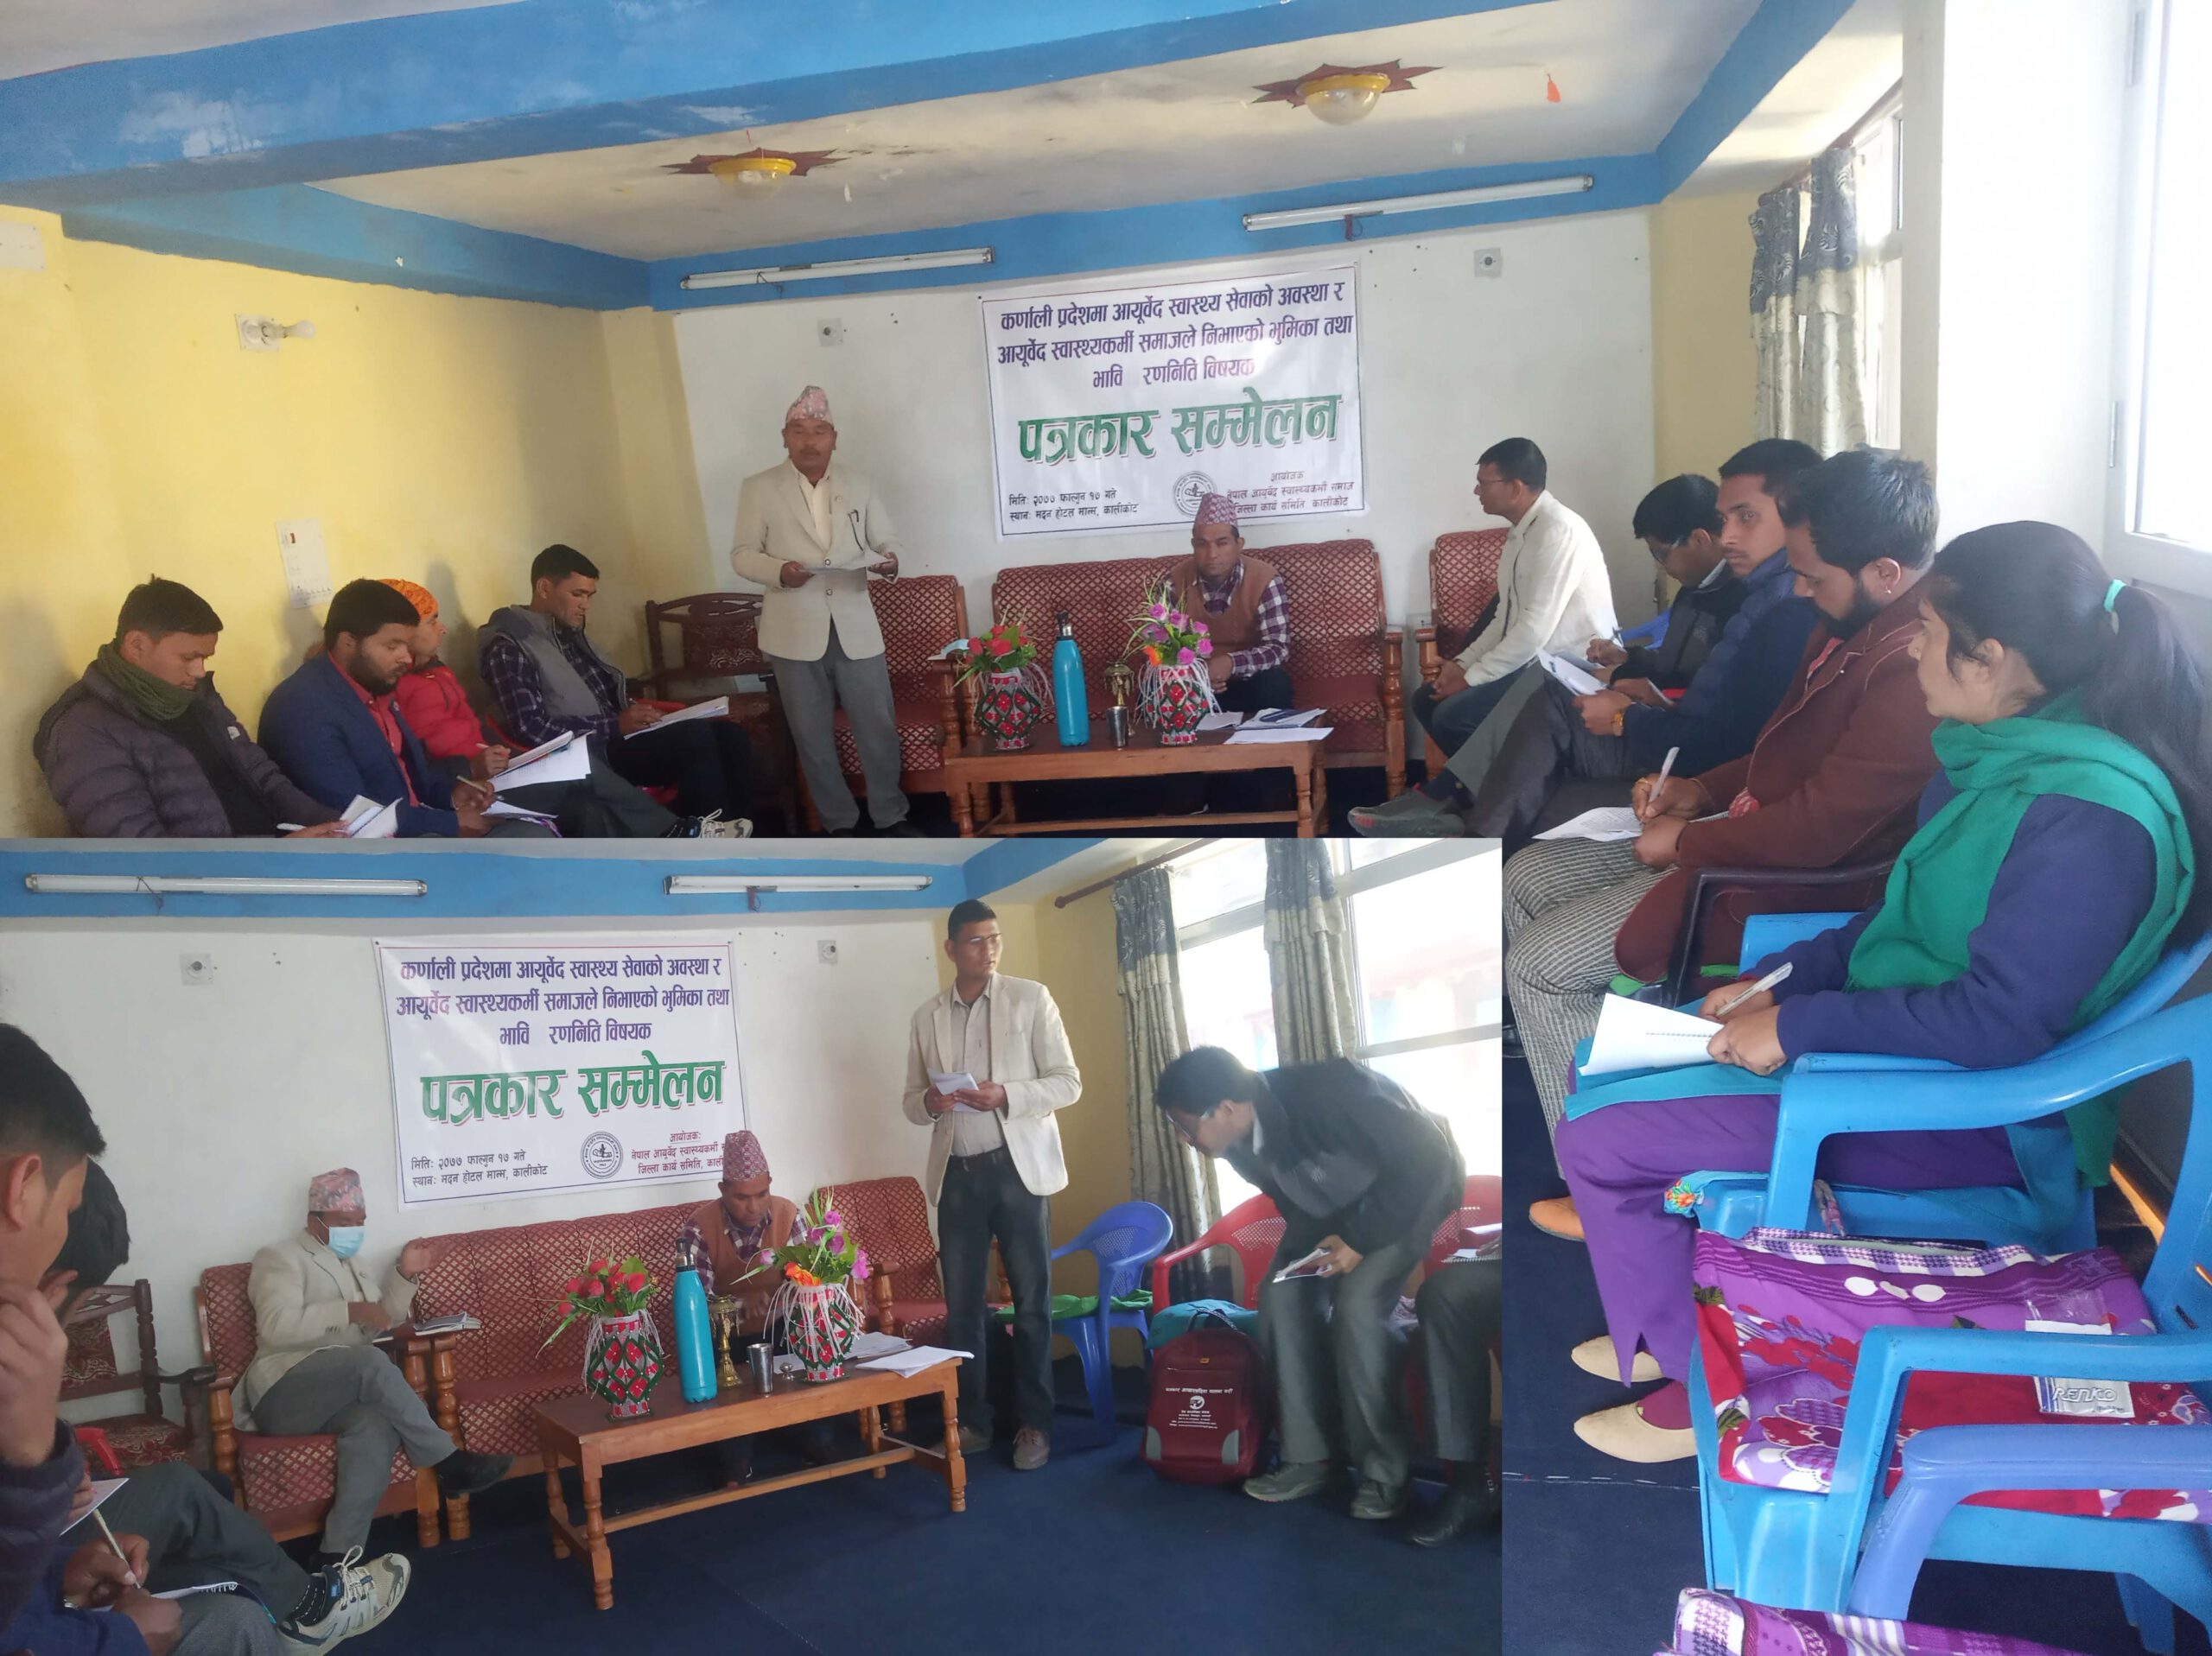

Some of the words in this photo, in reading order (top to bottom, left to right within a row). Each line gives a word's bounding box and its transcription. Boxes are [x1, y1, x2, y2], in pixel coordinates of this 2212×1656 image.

[1001, 304, 1052, 330] कर्णाली
[1058, 302, 1108, 328] प्रदेशमा
[1112, 295, 1164, 324] आयूर्वेद
[1168, 294, 1221, 317] स्वास्थ्य
[1225, 283, 1274, 312] सेवाको
[1278, 282, 1329, 305] अवस्था
[1333, 282, 1345, 301] र
[998, 338, 1047, 367] आयूर्वेद
[1051, 330, 1135, 360] स्वास्थ्यकर्मी
[1139, 324, 1198, 352] समाजले
[1202, 318, 1265, 346] निभाएको
[1269, 314, 1319, 345] भुमिका
[1324, 314, 1354, 335] तथा
[1093, 363, 1123, 389] भावि
[1142, 357, 1198, 384] रणनिति
[1204, 355, 1255, 379] विषयक
[1017, 409, 1162, 466] पत्रकार
[1171, 386, 1343, 456] सम्मेलन
[1033, 494, 1056, 507] २०७७
[1104, 487, 1117, 499] गते
[1055, 505, 1075, 520] होटल
[1103, 501, 1140, 515] कालीकोट
[1313, 495, 1349, 508] कालीकोट
[400, 955, 456, 981] कर्णाली
[461, 955, 512, 981] प्रदेशमा
[516, 955, 566, 984] आयूर्वेद
[569, 960, 619, 980] स्वास्थ्य
[622, 954, 663, 978] सेवाको
[667, 958, 709, 977] अवस्था
[713, 958, 722, 975] र
[396, 990, 451, 1020] आयूर्वेद
[455, 987, 539, 1015] स्वास्थ्यकर्मी
[543, 987, 598, 1012] समाजले
[602, 986, 658, 1009] निभाएको
[662, 984, 703, 1012] भुमिका
[707, 988, 730, 1007] तथा
[499, 1020, 530, 1045] भावि
[549, 1018, 601, 1044] रणनिति
[606, 1018, 652, 1042] विषयक
[420, 1068, 568, 1126] पत्रकार
[577, 1049, 727, 1116] सम्मेलन
[438, 1158, 462, 1171] २०७७
[467, 1153, 495, 1167] फाल्गुन
[498, 1153, 510, 1164] १७
[513, 1149, 526, 1162] गते
[631, 1149, 650, 1160] नेपाल
[441, 1172, 459, 1185] मदन
[462, 1170, 483, 1184] होटल
[512, 1163, 549, 1177] कालीकोट
[638, 1163, 659, 1175] जिल्ला
